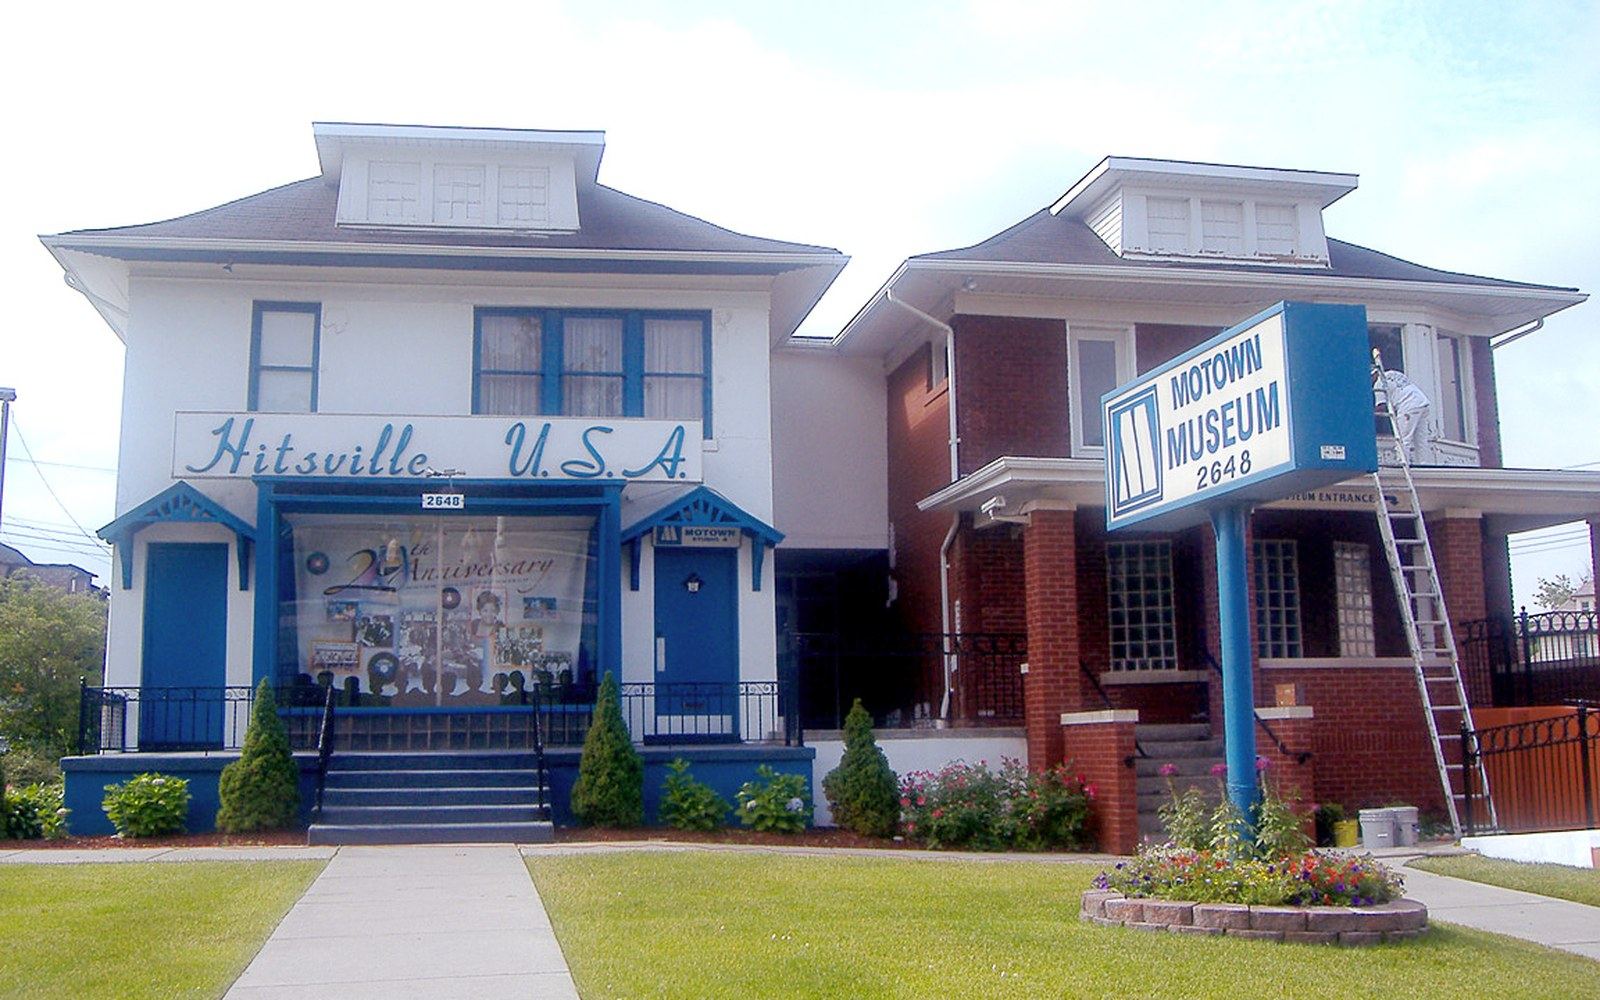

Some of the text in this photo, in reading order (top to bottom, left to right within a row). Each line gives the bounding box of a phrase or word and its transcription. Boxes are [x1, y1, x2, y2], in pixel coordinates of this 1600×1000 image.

[1171, 334, 1263, 410] MOTOWN
[185, 417, 428, 474] Hitsville
[1167, 381, 1280, 470] MUSEUM
[1197, 450, 1252, 490] 2648
[427, 496, 460, 506] 2648
[1319, 493, 1376, 504] ENTRANCE
[410, 556, 554, 593] Anniversary
